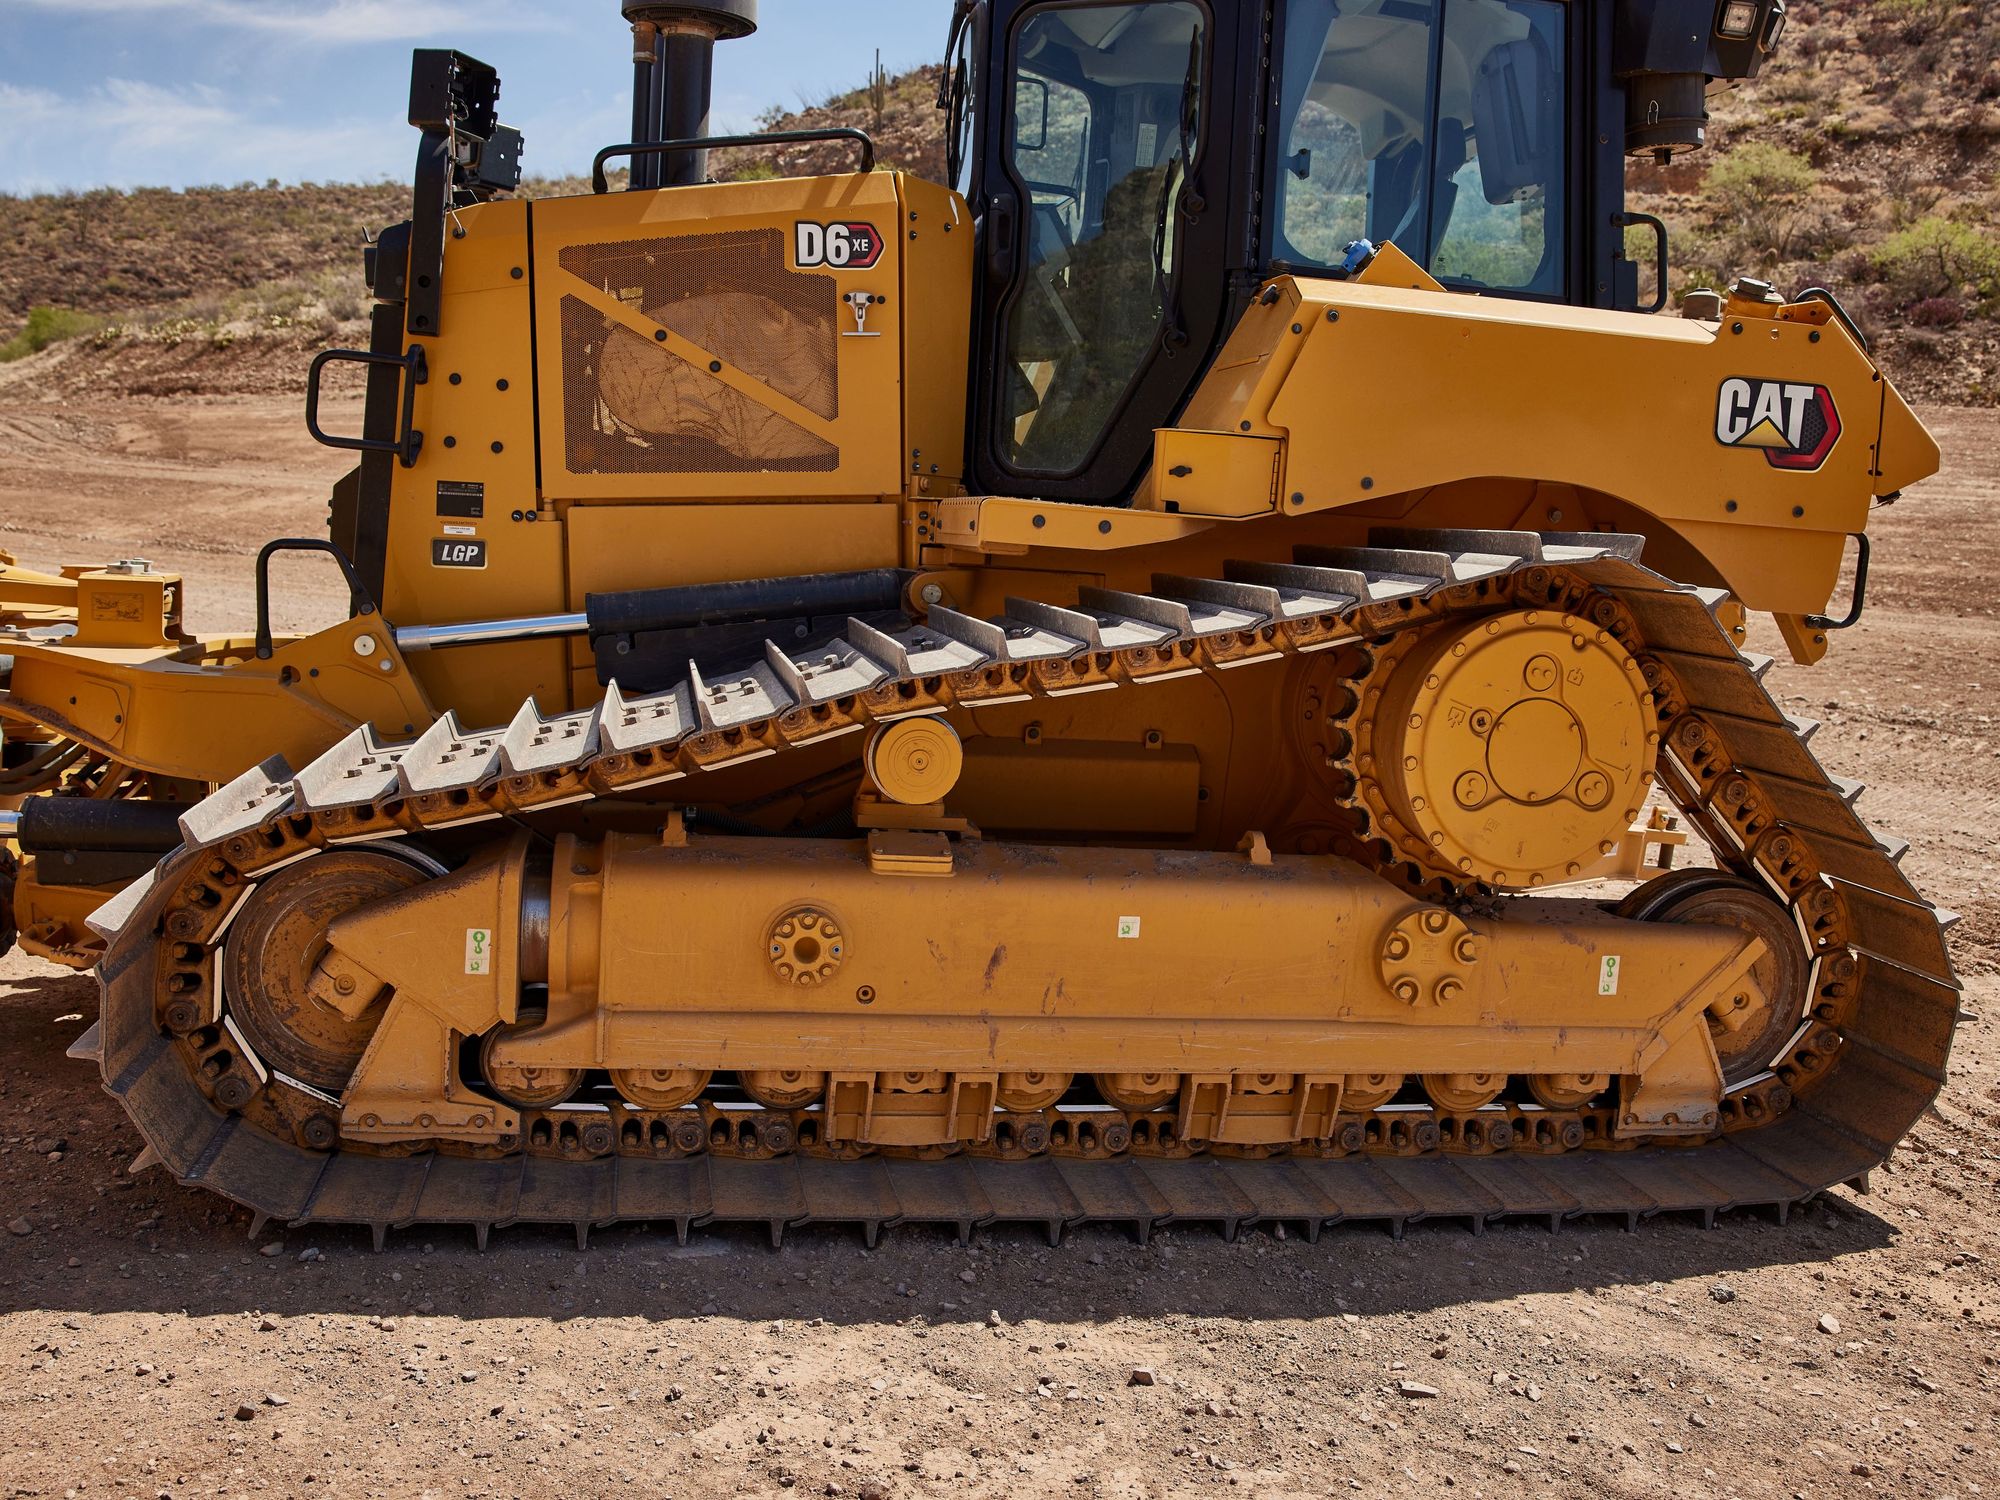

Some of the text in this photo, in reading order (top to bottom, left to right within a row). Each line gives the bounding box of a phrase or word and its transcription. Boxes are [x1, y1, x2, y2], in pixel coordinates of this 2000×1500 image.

[797, 223, 869, 265] D6 XE
[1717, 378, 1815, 449] CAT
[441, 544, 479, 562] LGP
